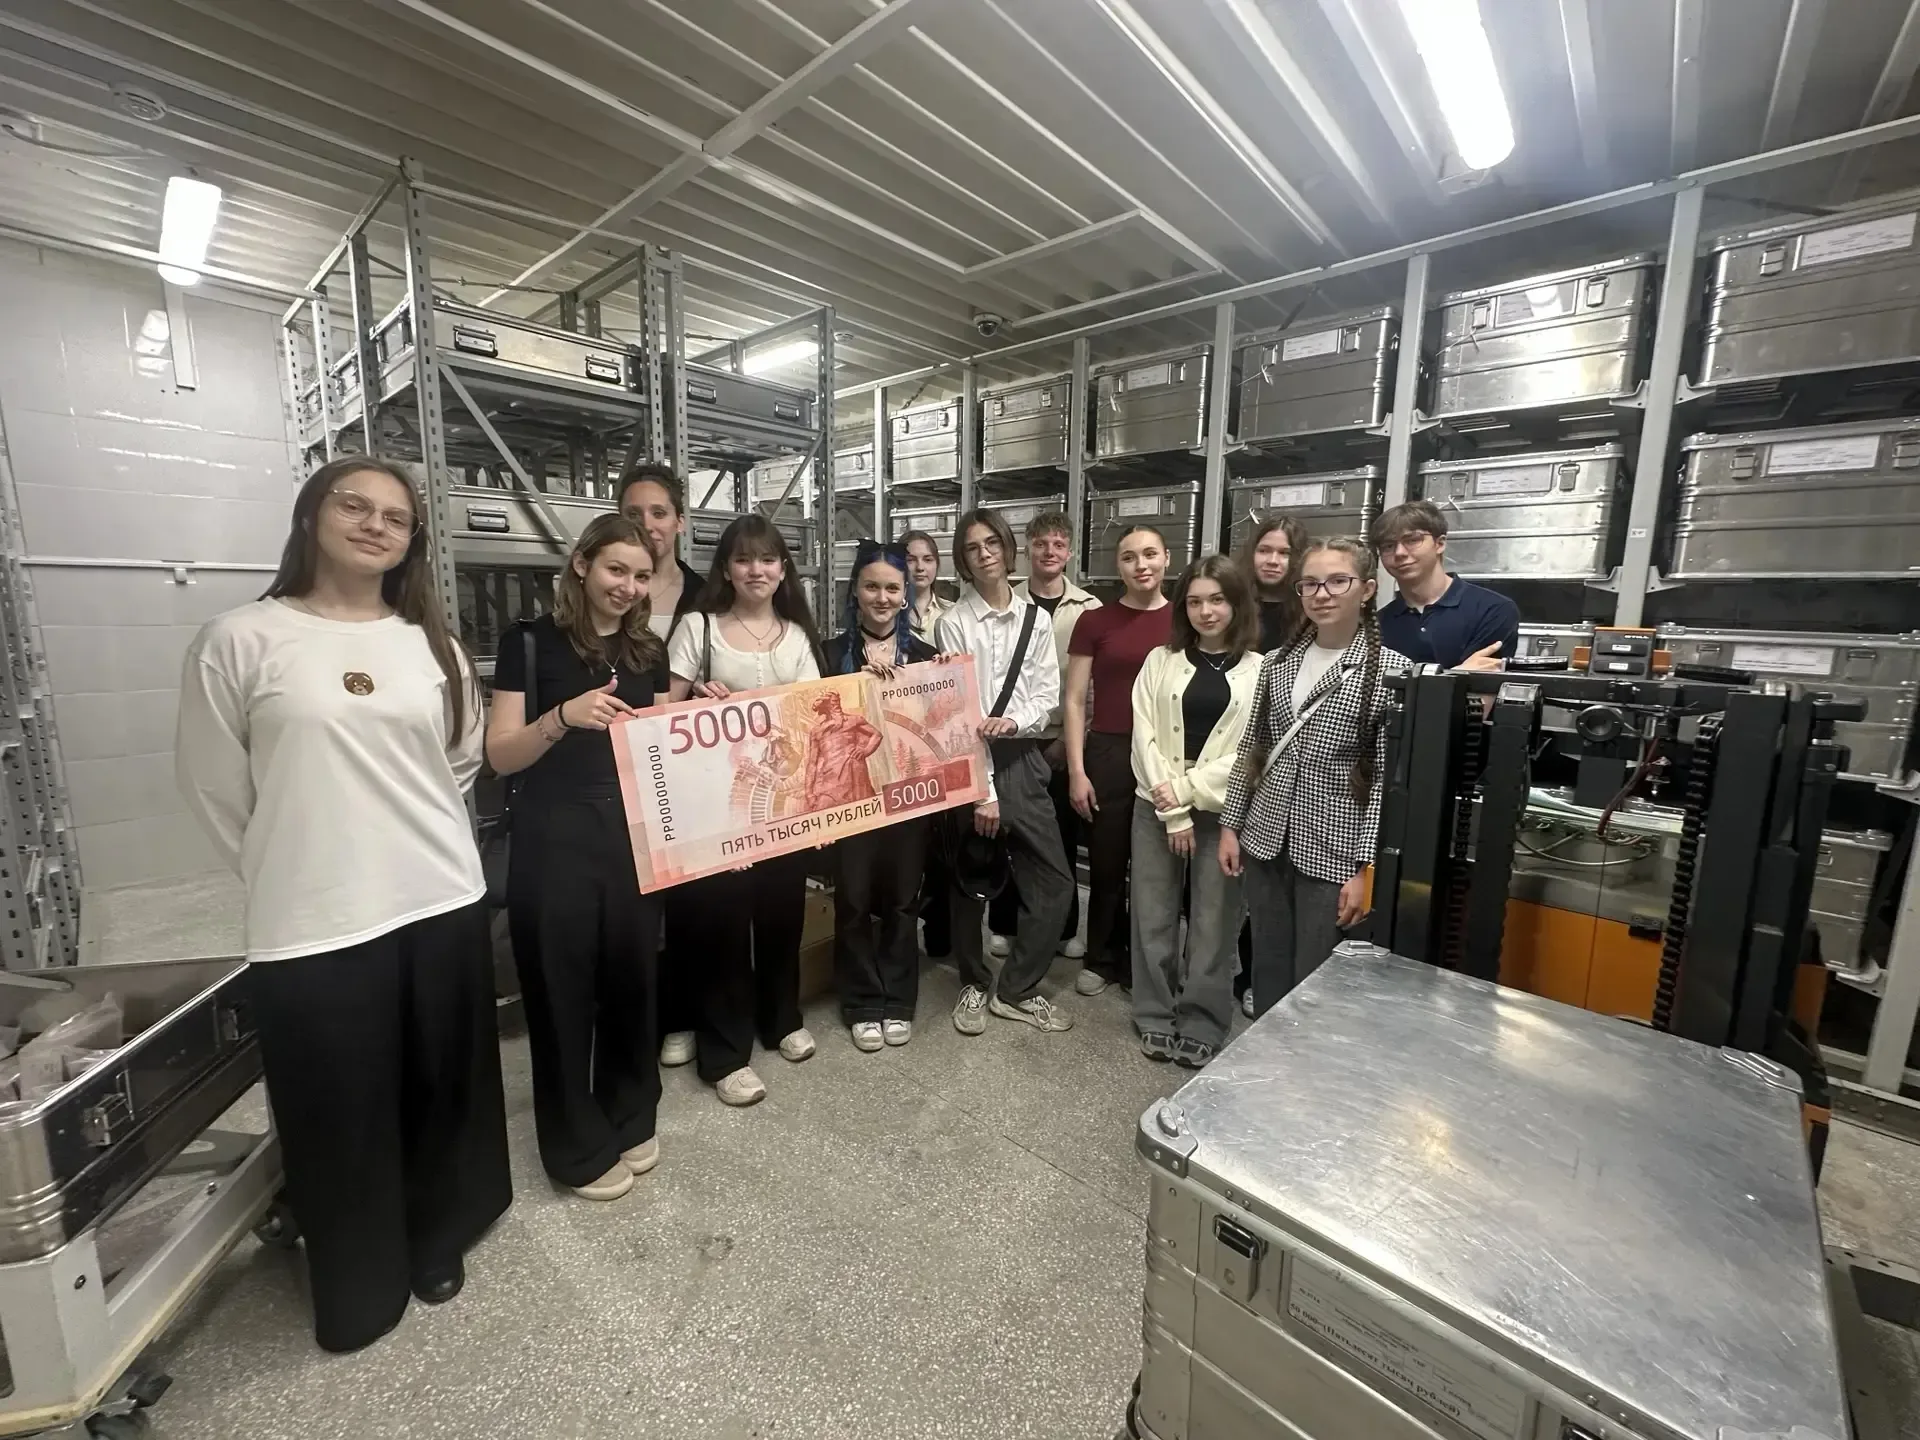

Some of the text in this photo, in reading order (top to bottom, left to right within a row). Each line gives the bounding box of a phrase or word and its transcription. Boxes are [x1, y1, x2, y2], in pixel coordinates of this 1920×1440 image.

[669, 701, 771, 755] 5000
[891, 778, 939, 809] 5000
[721, 798, 882, 856] ПЯТЬ ТЫСЯЧ РУБЛЕЙ
